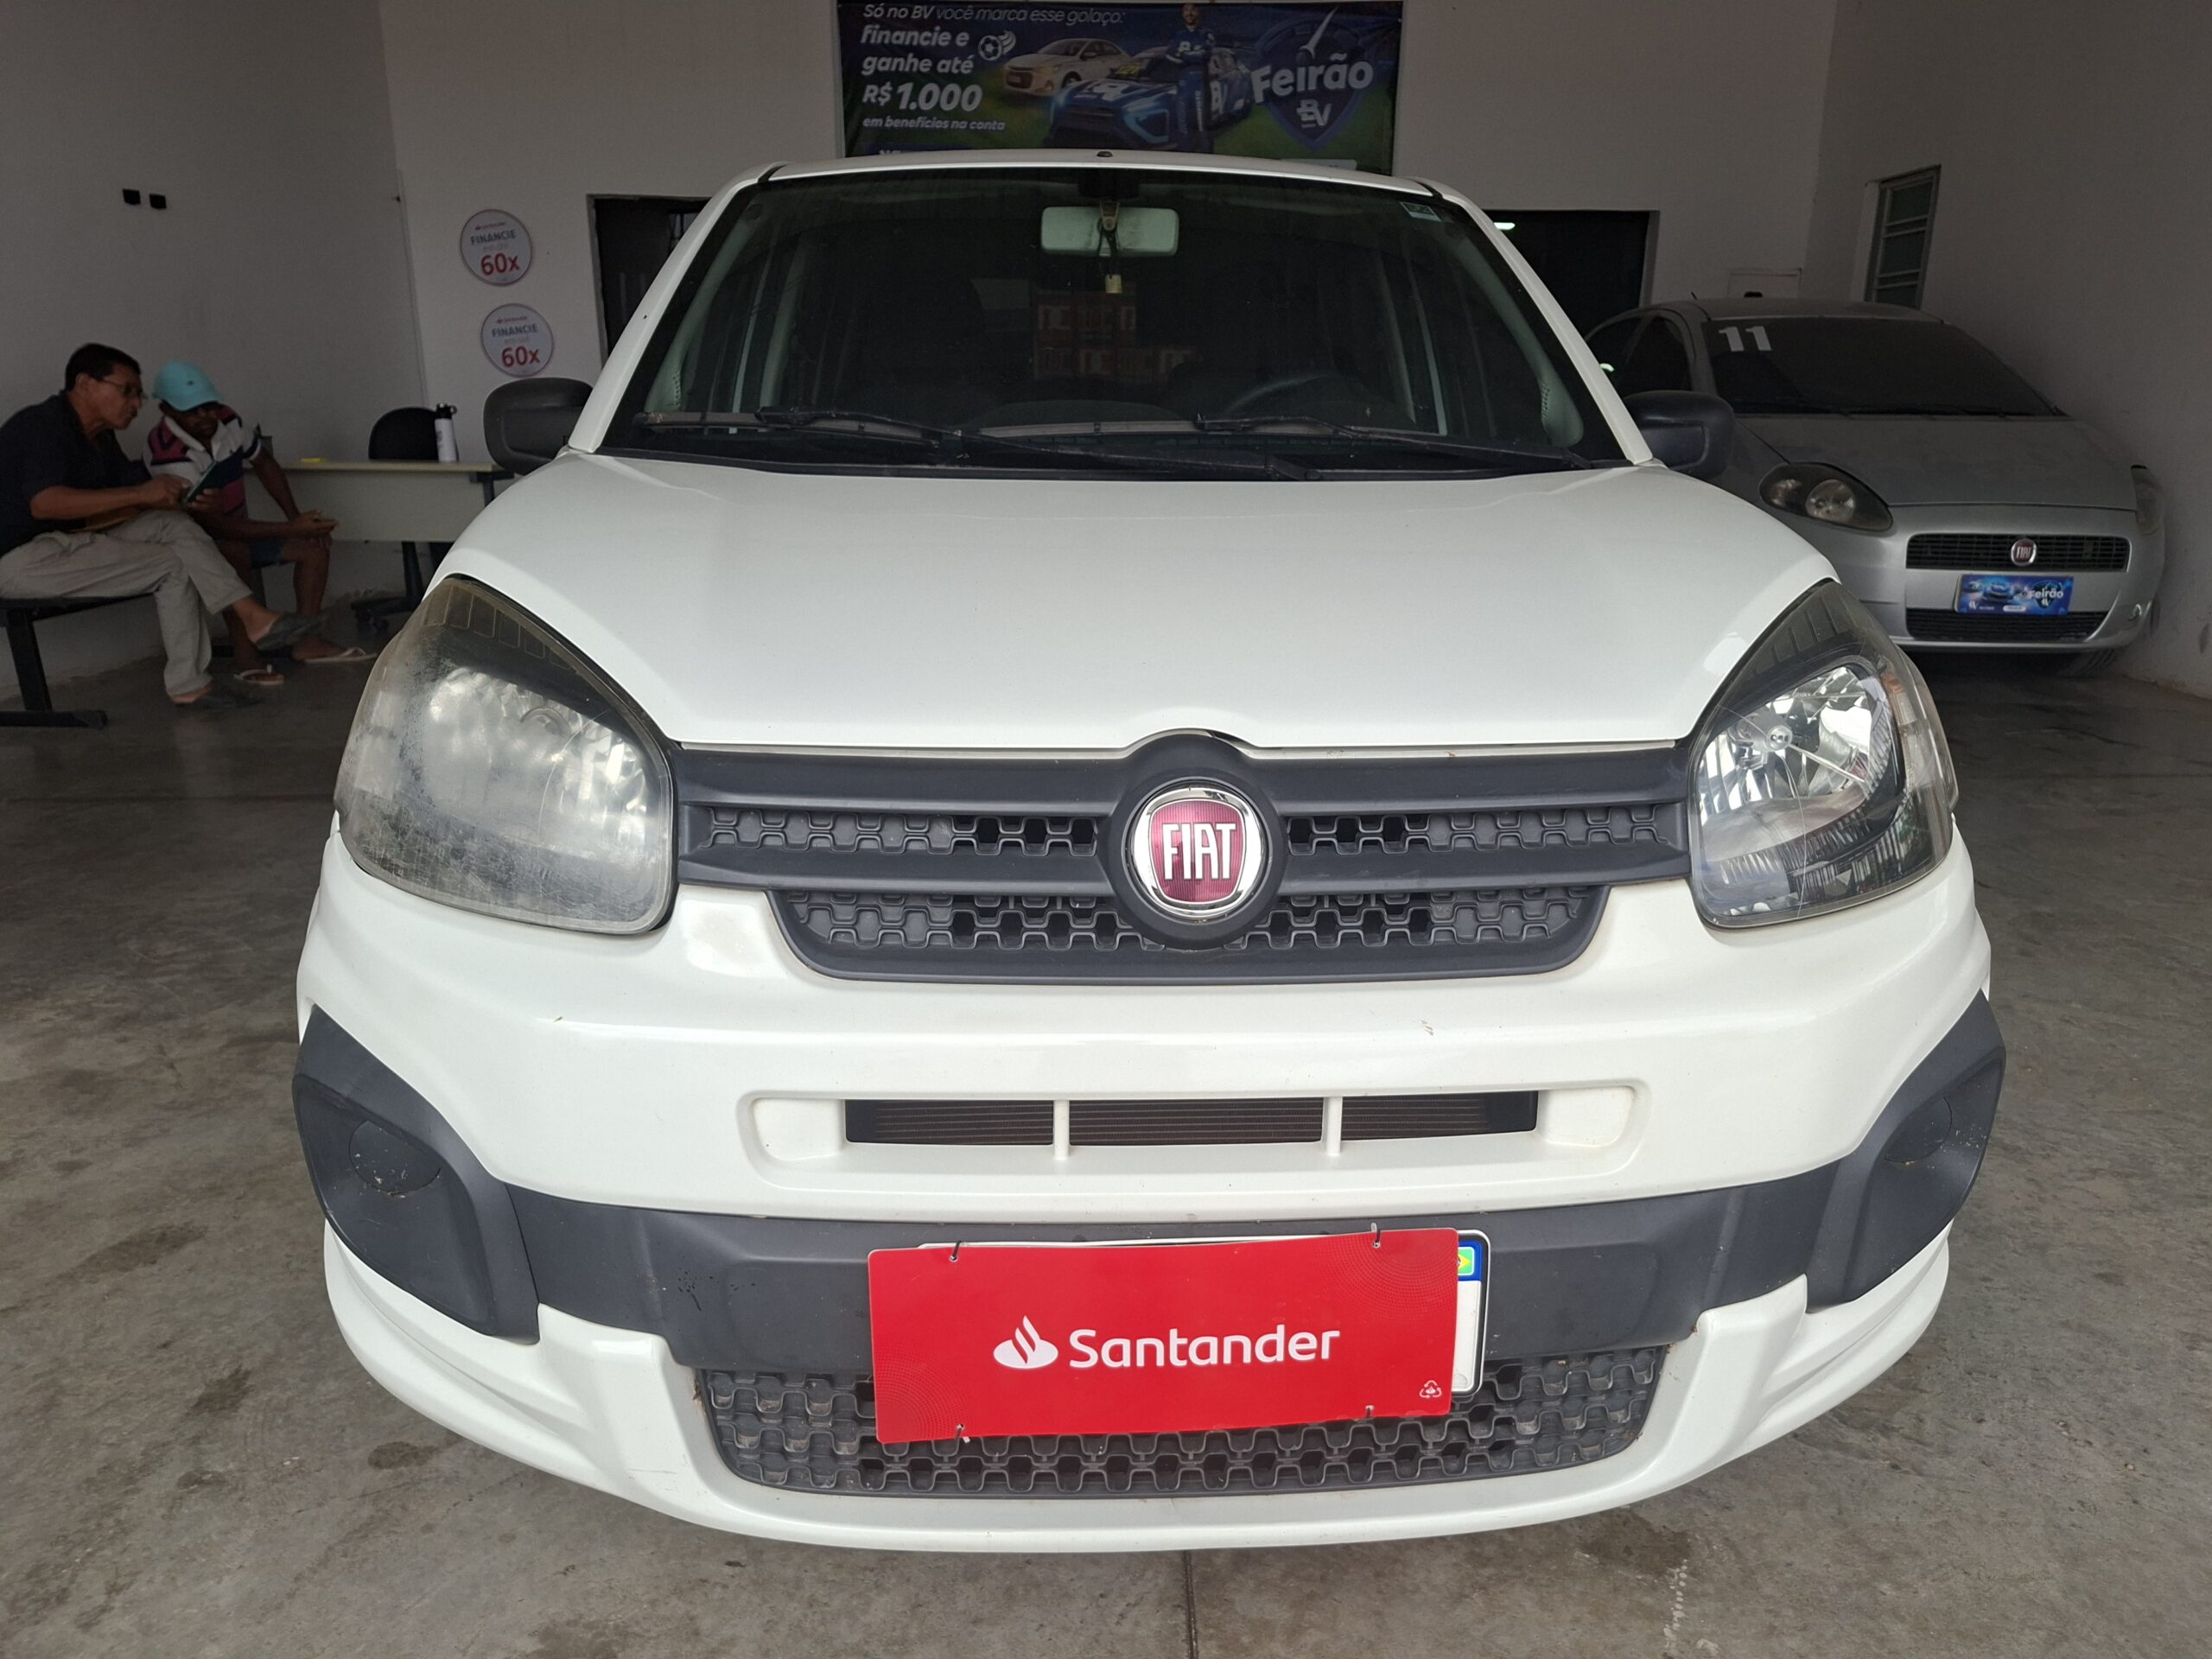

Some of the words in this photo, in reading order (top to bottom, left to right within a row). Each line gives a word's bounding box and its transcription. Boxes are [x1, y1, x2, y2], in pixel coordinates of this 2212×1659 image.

[863, 4, 884, 18] Só
[887, 8, 909, 19] no
[911, 5, 936, 19] BV
[937, 6, 974, 20] você
[975, 9, 1028, 22] marca
[1030, 10, 1065, 22] esse
[861, 24, 951, 46] financie
[955, 31, 969, 46] e
[861, 53, 932, 75] ganhe
[937, 55, 975, 74] até
[1251, 52, 1374, 104] Feirão
[862, 81, 893, 106] R$
[896, 82, 982, 111] 1.000
[862, 118, 883, 129] em
[885, 116, 950, 130] benefícios
[950, 119, 968, 130] na
[969, 119, 1006, 130] conta
[471, 229, 518, 245] FINANCIE
[481, 252, 520, 276] 60x
[492, 323, 538, 337] FINANCIE
[1719, 326, 1771, 353] 11
[501, 346, 540, 367] 60x
[2016, 546, 2032, 559] FIAT
[1162, 823, 1236, 880] FIAT
[1069, 1324, 1340, 1369] Santander
